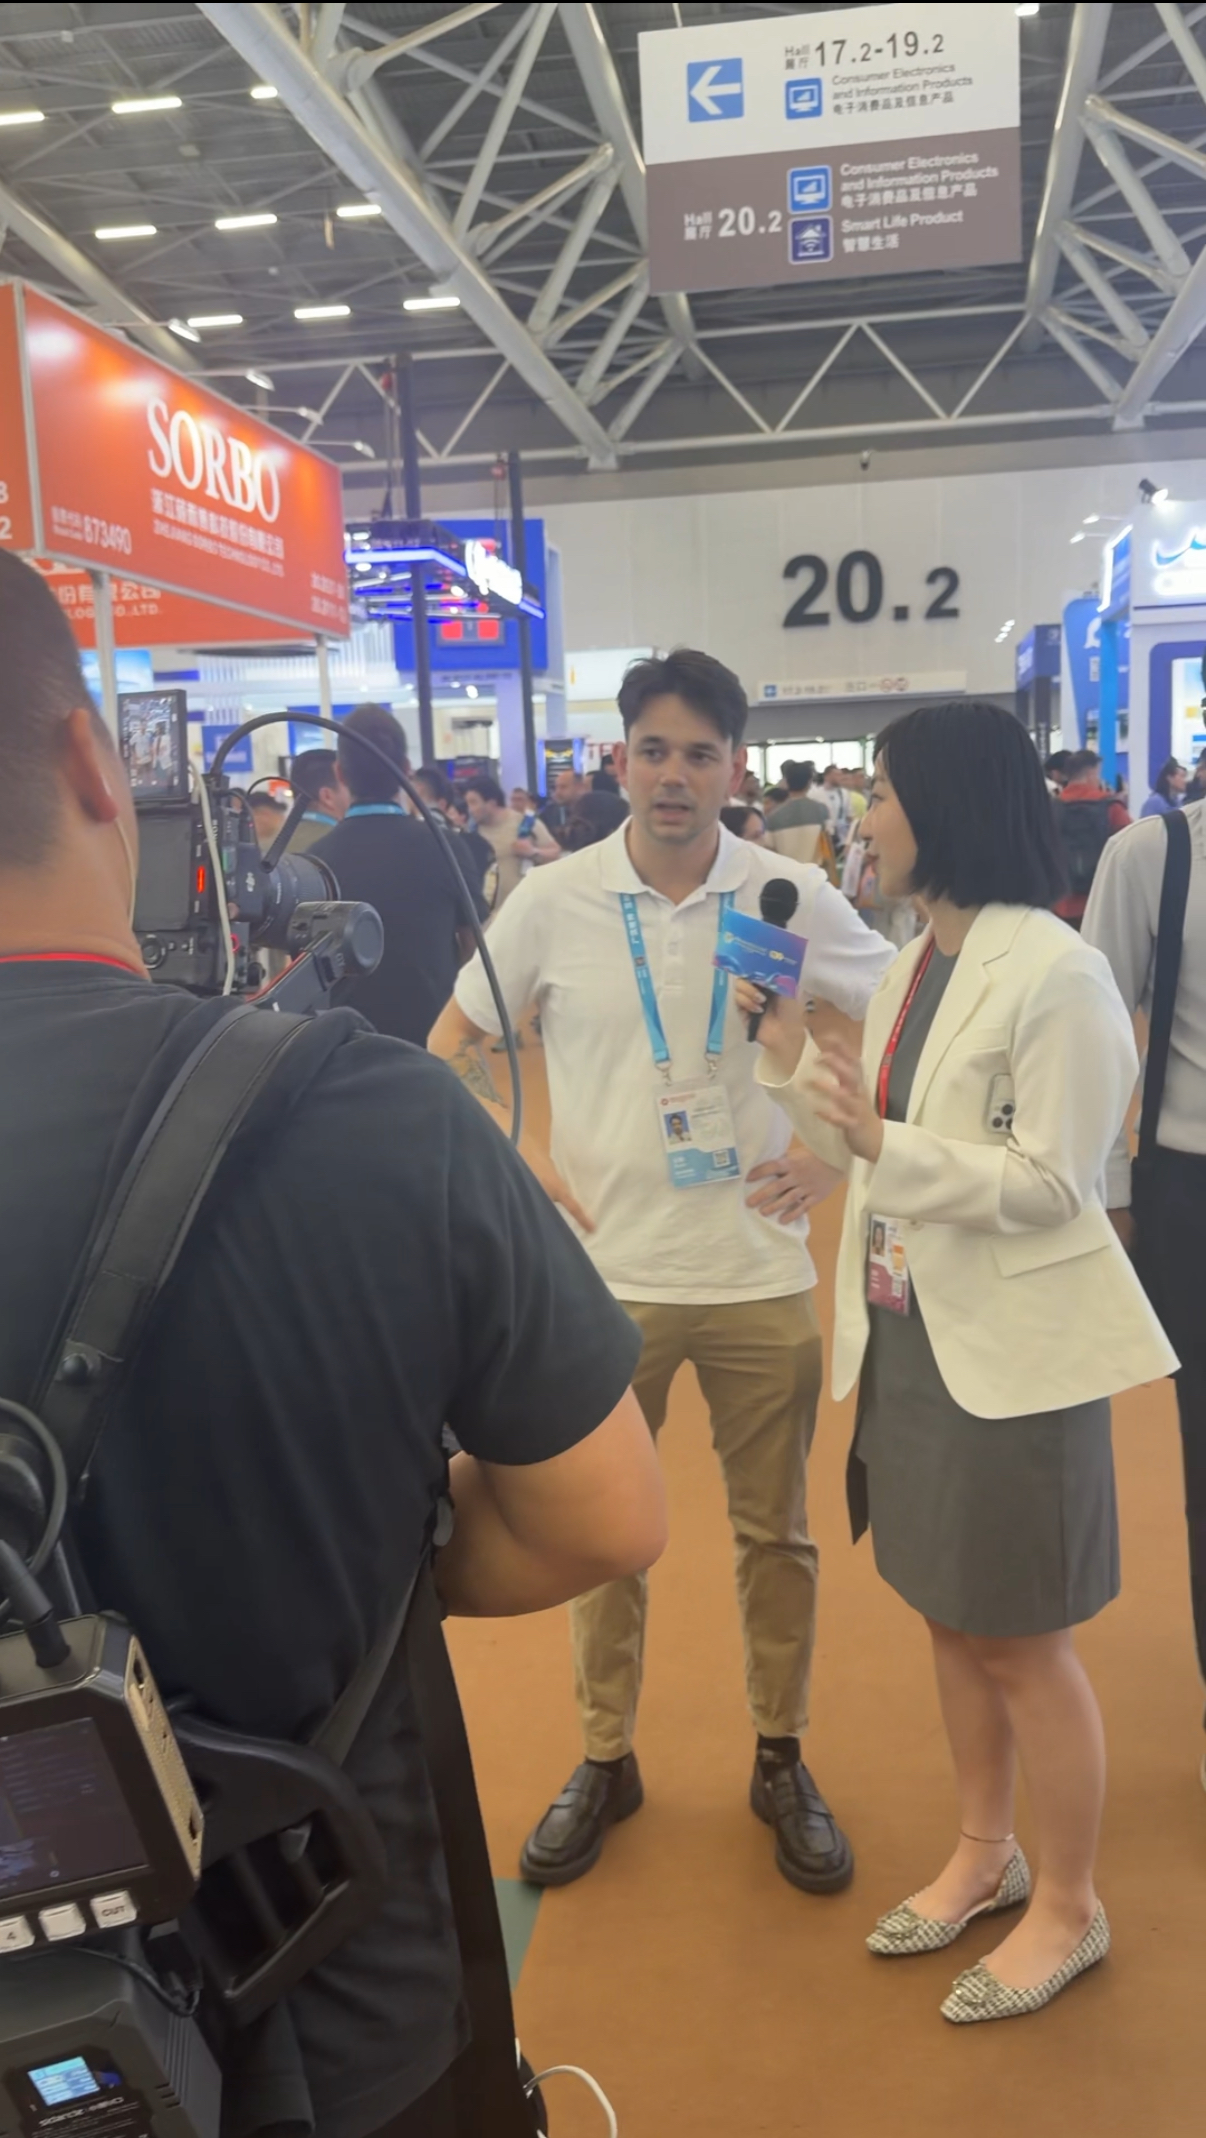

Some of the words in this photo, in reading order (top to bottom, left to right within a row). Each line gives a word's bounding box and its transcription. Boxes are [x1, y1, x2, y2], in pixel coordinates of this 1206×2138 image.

[784, 44, 810, 57] Hall
[815, 31, 944, 67] 17.2-19.2
[832, 71, 891, 85] Consumer
[893, 64, 956, 79] Electronics
[833, 89, 853, 100] and
[856, 81, 920, 98] Information
[923, 76, 973, 90] Products
[833, 91, 954, 115] 电子消费品及信息产品
[840, 159, 906, 176] Consumer
[908, 153, 979, 169] Electronics
[840, 180, 865, 192] and
[867, 171, 939, 189] Information
[941, 166, 999, 182] Products
[840, 183, 977, 209] 电子消费品及信息产品
[684, 212, 713, 226] Hall
[717, 206, 783, 238] 20.2
[841, 217, 882, 234] Smart
[884, 213, 908, 228] Life
[911, 210, 963, 226] Product
[843, 234, 899, 253] 智慧生活
[147, 397, 281, 523] SORBO
[781, 550, 960, 629] 20.2
